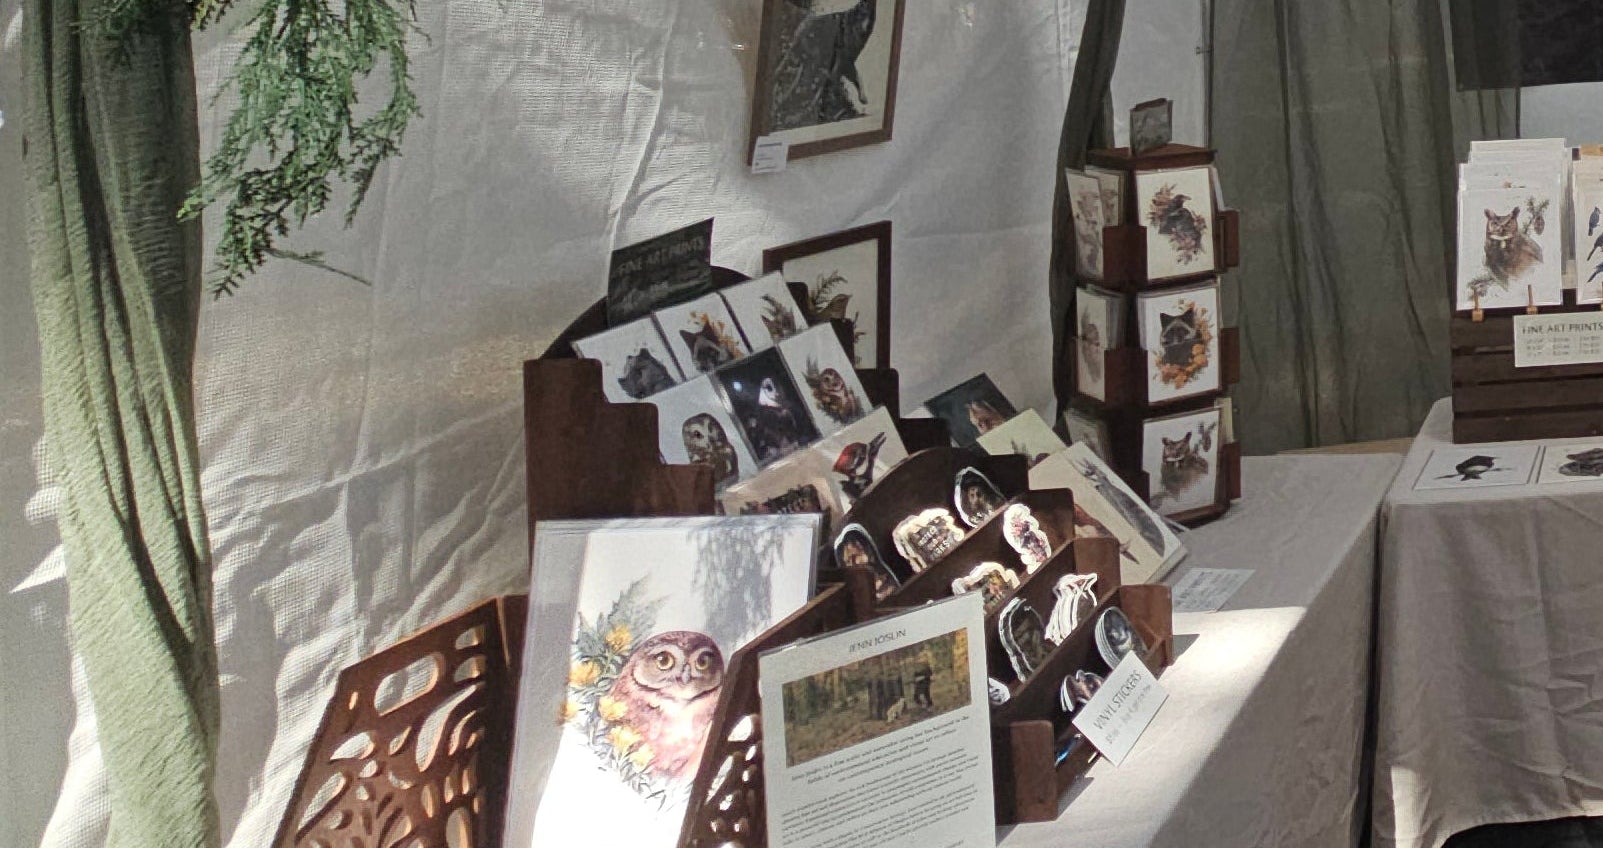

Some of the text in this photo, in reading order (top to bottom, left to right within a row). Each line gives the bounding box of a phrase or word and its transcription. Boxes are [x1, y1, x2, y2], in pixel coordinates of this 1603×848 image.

[1522, 322, 1603, 335] FINE ART PRINTS
[1093, 704, 1117, 729] VINYL
[1112, 669, 1142, 708] STICKERS
